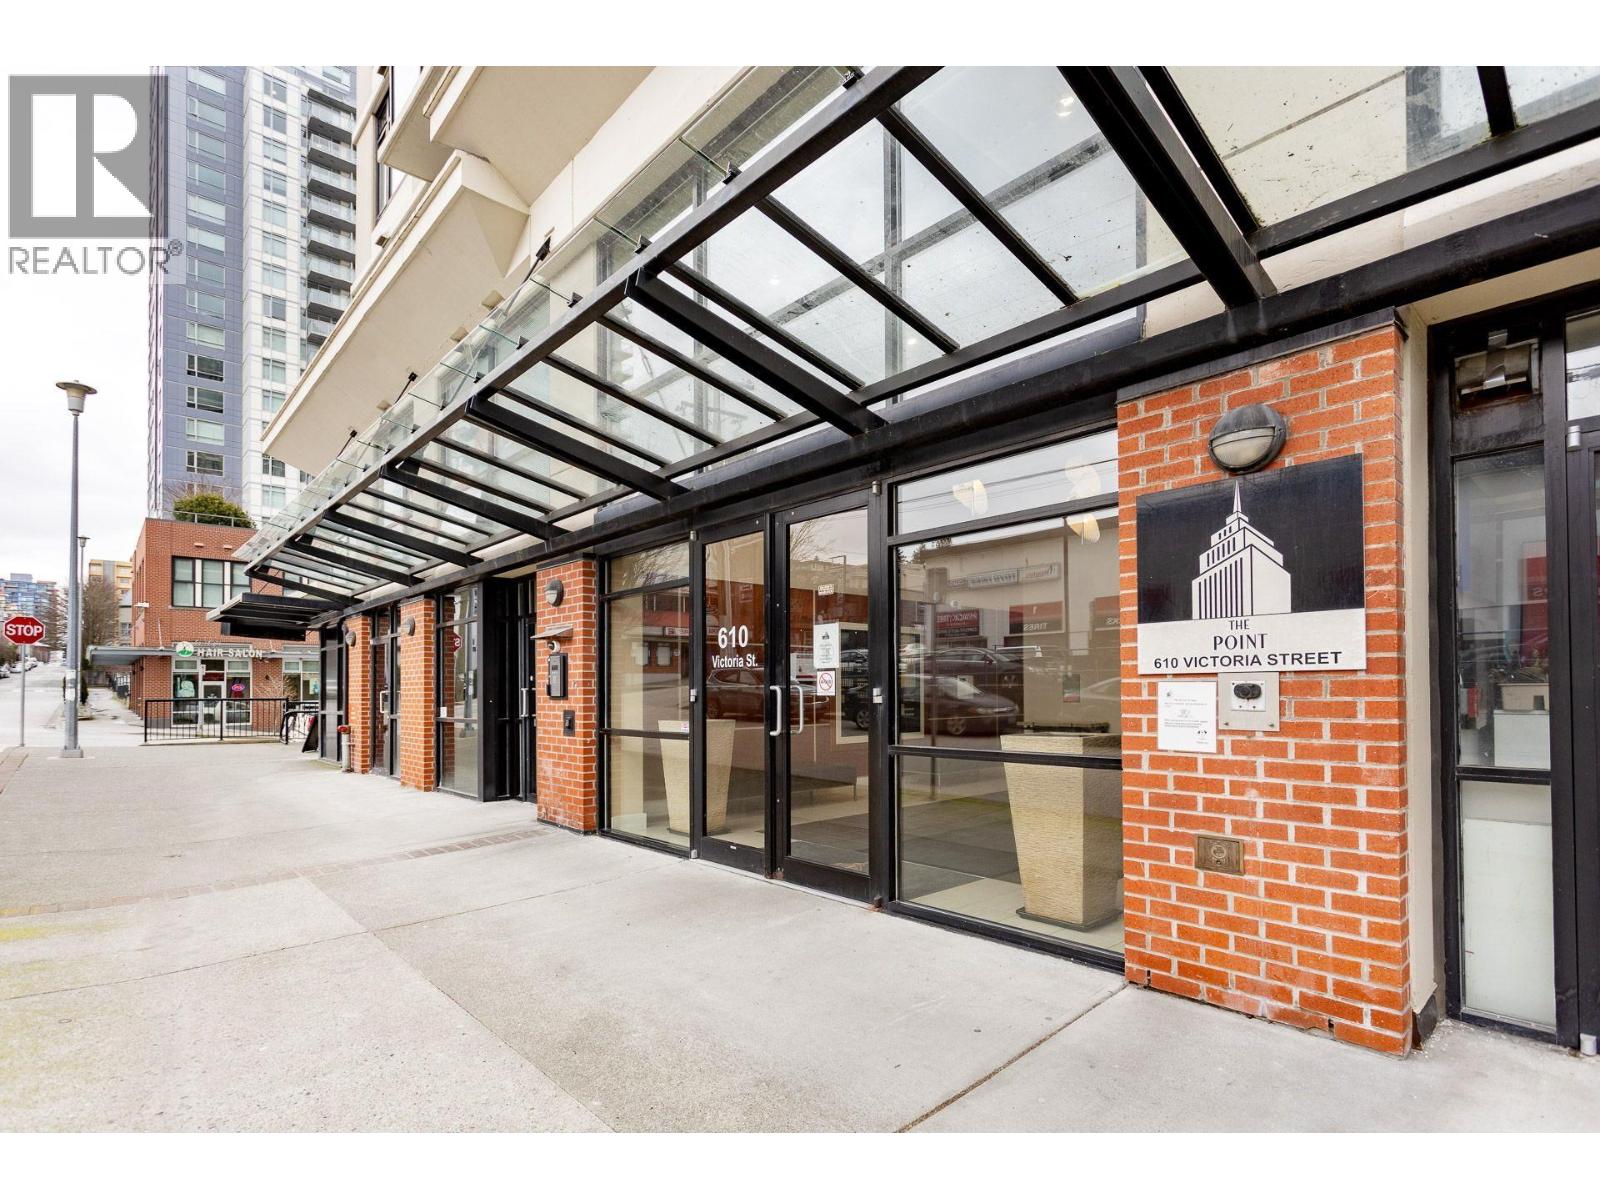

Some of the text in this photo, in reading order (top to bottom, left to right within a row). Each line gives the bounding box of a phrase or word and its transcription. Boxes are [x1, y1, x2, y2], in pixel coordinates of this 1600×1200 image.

[6, 624, 42, 636] STOP
[1228, 619, 1250, 630] THE
[718, 625, 749, 649] 610
[1213, 633, 1268, 651] POINT
[197, 648, 263, 658] HAIR SALON
[711, 653, 758, 669] Victoria St.
[1154, 651, 1342, 669] 610 VICTORIA STREET
